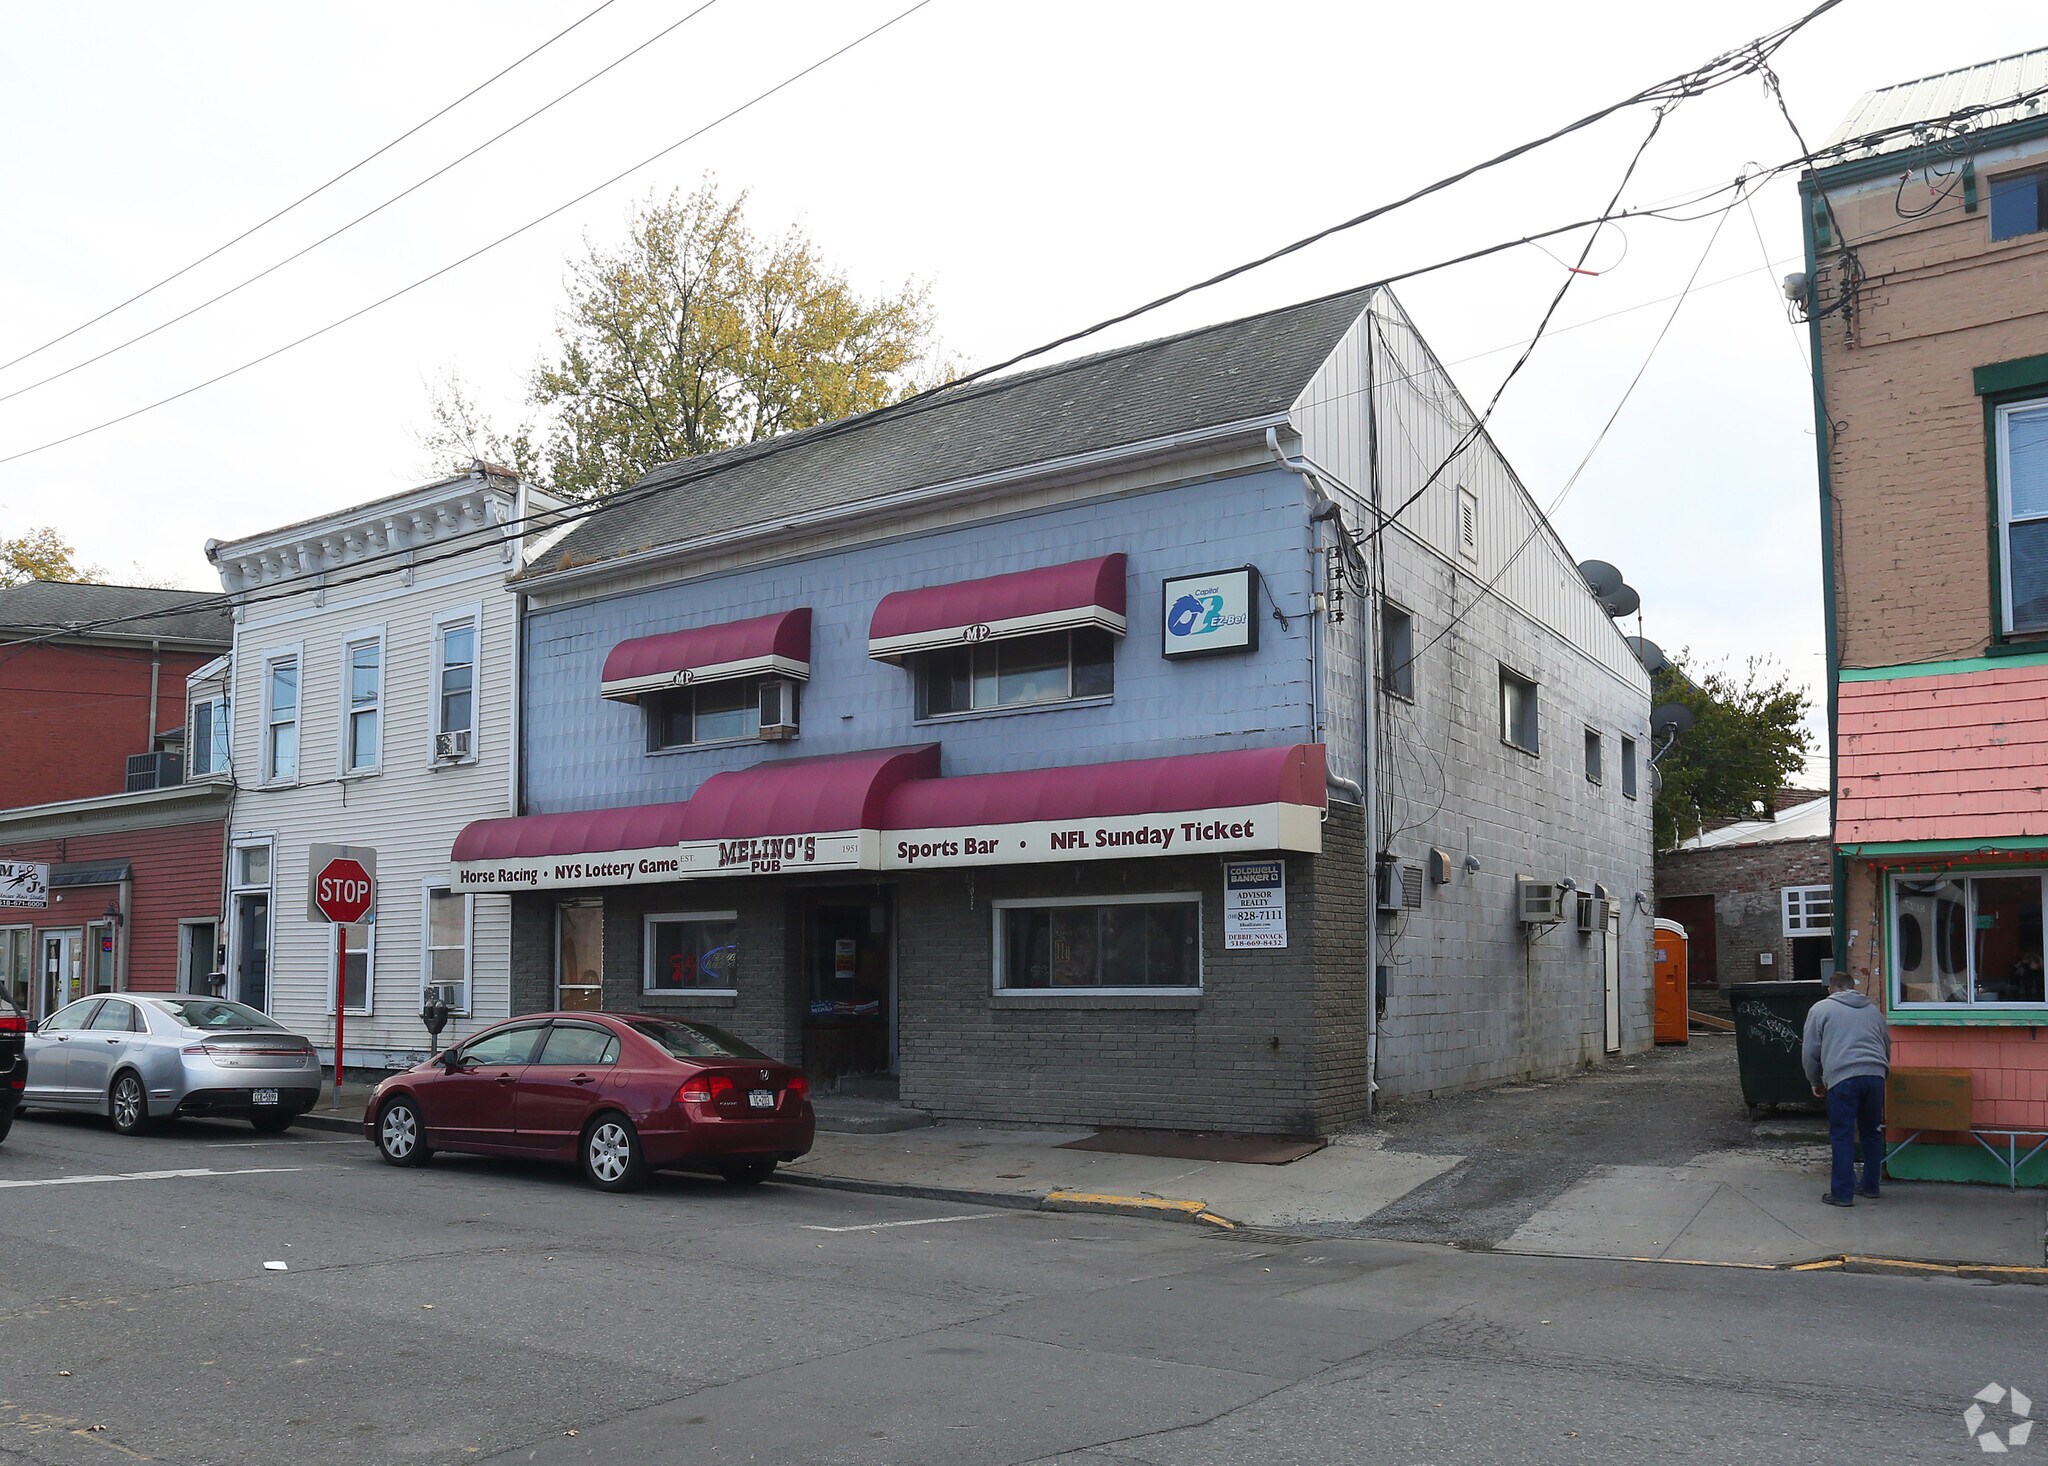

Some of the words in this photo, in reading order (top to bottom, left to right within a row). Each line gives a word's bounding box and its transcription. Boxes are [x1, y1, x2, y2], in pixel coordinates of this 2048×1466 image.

[1195, 587, 1219, 596] Capital
[1210, 613, 1246, 627] EZ-Bet
[966, 625, 988, 641] MP
[675, 671, 692, 684] MP
[897, 838, 959, 864] Sports
[964, 837, 1000, 855] Bar
[1050, 830, 1090, 850] NFL
[1095, 825, 1175, 850] Sunday
[1180, 818, 1255, 842] Ticket
[718, 836, 816, 867] MELINO'S
[842, 845, 858, 853] 1951
[460, 870, 495, 884] Horse
[499, 868, 538, 885] Racing
[555, 864, 582, 880] NYS
[585, 862, 634, 880] Lottery
[638, 858, 679, 874] Game
[751, 860, 781, 873] PUB
[1230, 866, 1279, 875] COLDWELL
[1230, 874, 1269, 883] BANKER
[26, 881, 46, 893] J's
[320, 878, 368, 903] STOP
[1237, 891, 1272, 899] ADVISOR
[1237, 910, 1282, 920] 828-7111
